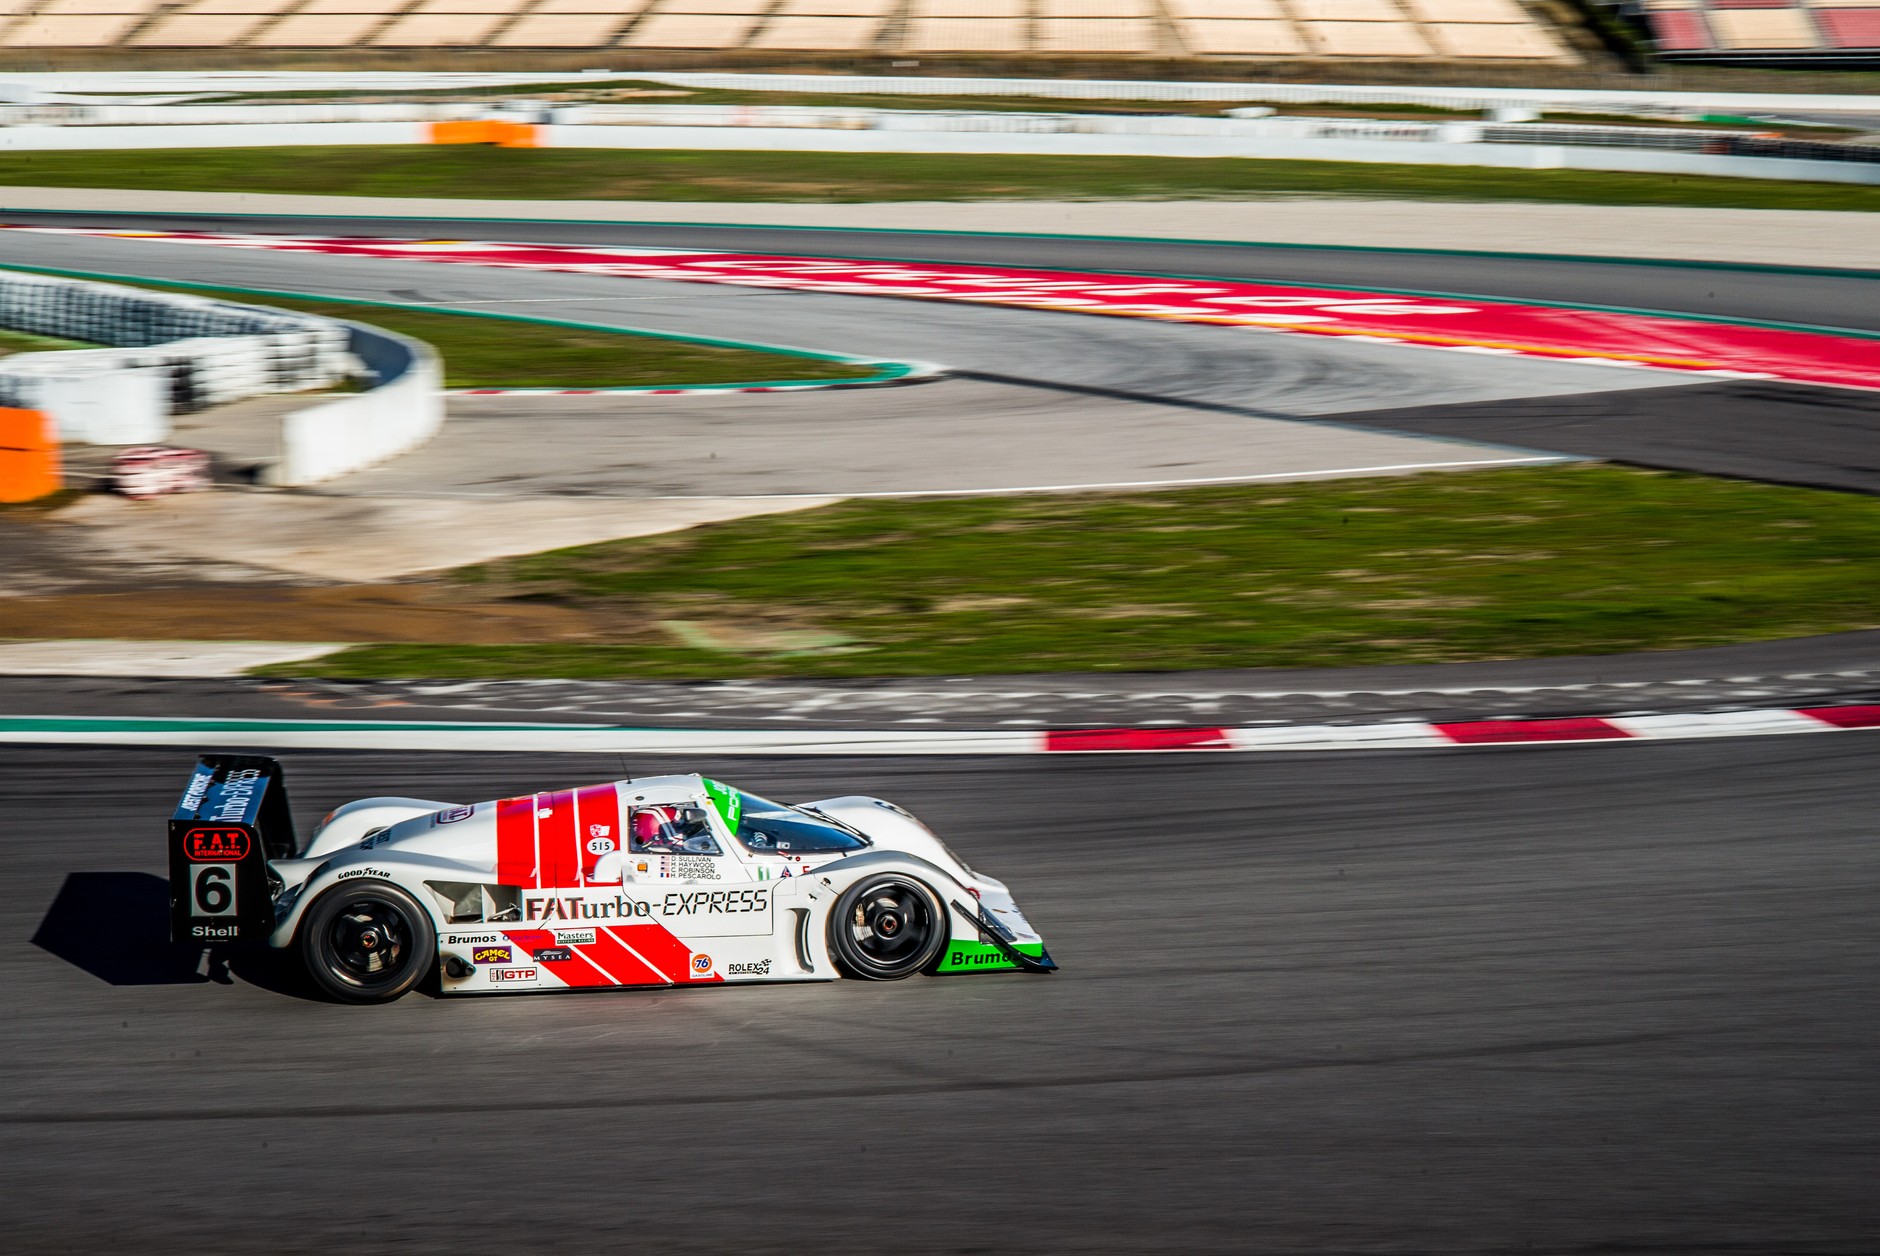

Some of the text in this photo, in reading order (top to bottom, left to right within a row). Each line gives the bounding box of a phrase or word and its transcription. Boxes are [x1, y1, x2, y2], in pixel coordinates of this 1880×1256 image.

[1193, 296, 1483, 315] de
[592, 842, 610, 851] 515
[194, 849, 242, 857] INTERNATIONAL
[678, 861, 716, 869] HAYWOOD
[338, 867, 391, 879] GOODYEAR
[678, 872, 722, 880] PESCAROLO
[195, 866, 233, 914] 6
[525, 889, 768, 921] FATurbo-EXPRESS
[192, 926, 239, 937] Shell
[557, 932, 594, 940] Masters
[448, 935, 497, 944] Brumos
[474, 949, 511, 961] CAMEL
[951, 951, 1016, 966] Brumo
[696, 958, 709, 968] 76
[728, 963, 760, 972] ROLEX
[504, 969, 536, 979] GTP
[757, 966, 770, 975] 24
